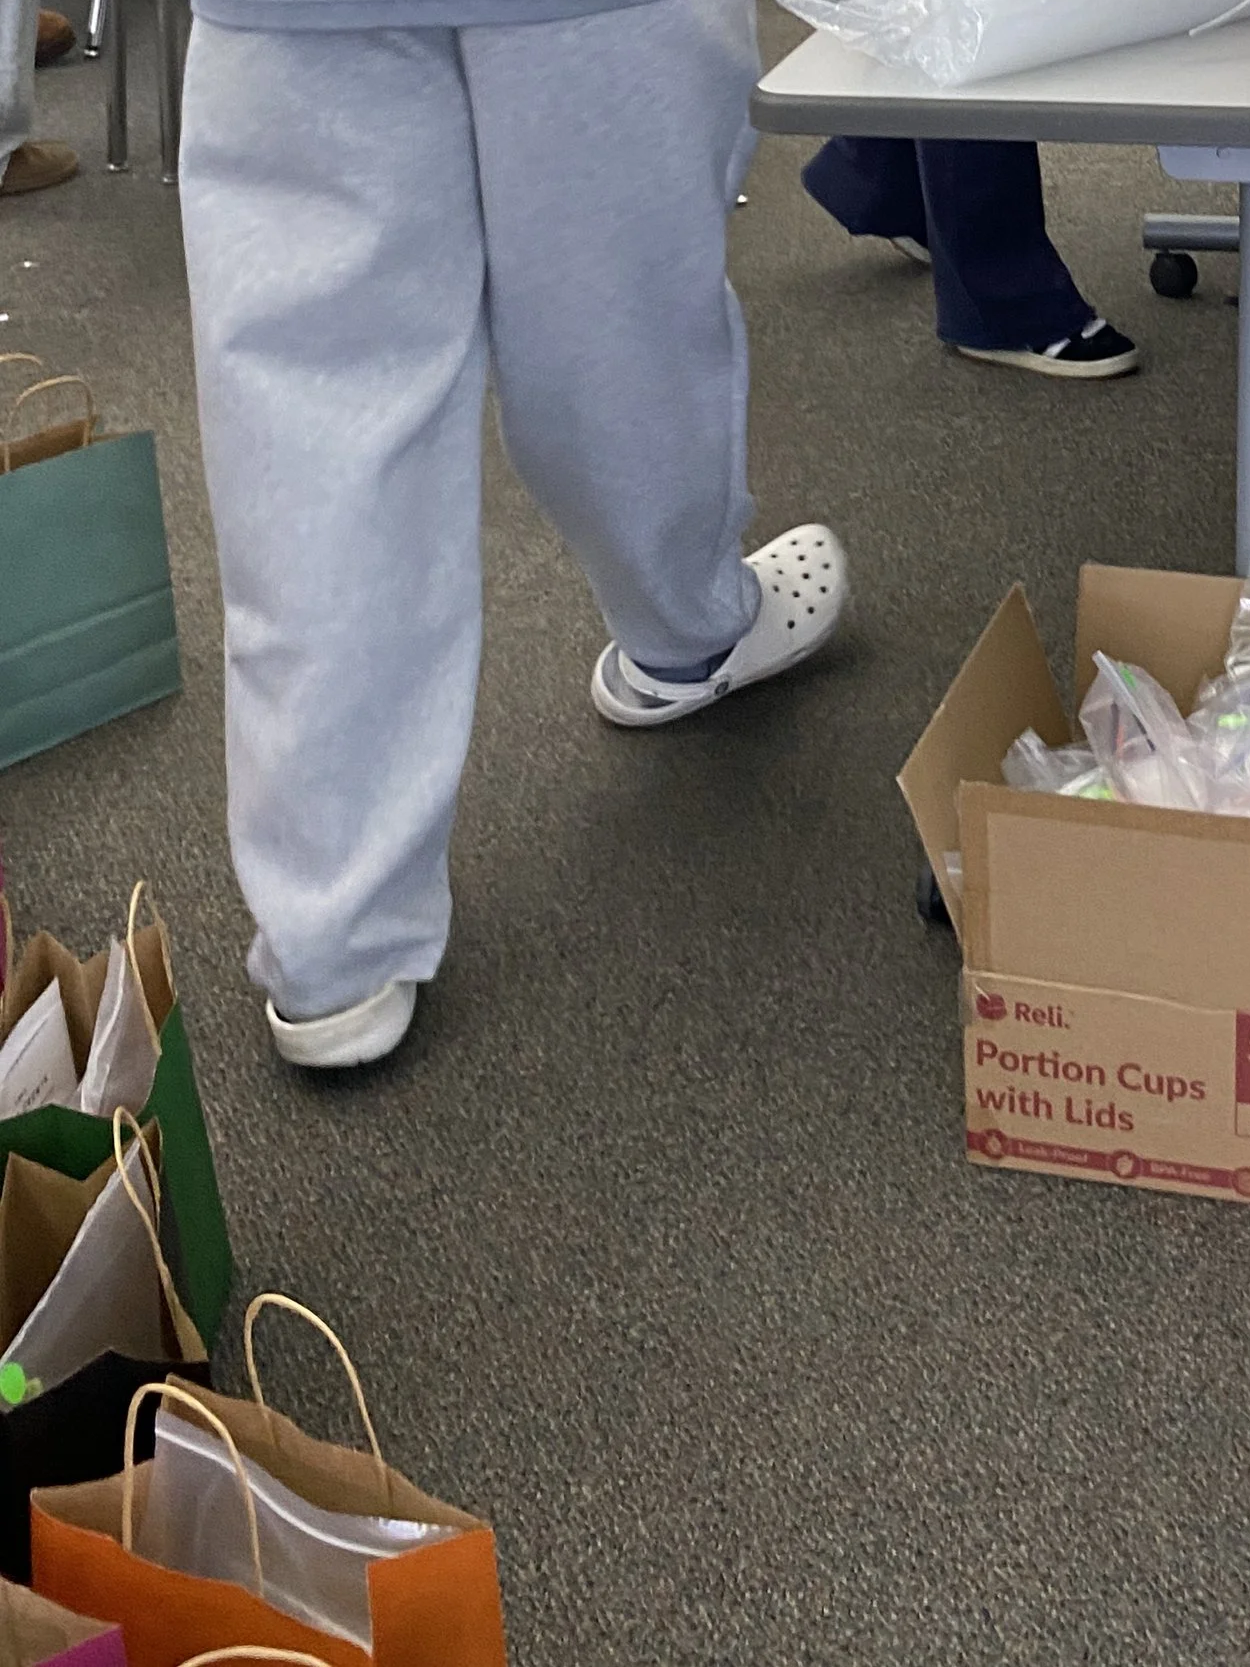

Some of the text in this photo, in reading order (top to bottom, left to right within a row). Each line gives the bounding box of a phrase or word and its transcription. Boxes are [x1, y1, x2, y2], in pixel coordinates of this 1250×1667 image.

[1014, 1001, 1071, 1030] Reli.
[976, 1038, 1207, 1102] Portion Cups
[976, 1086, 1136, 1132] with Lids
